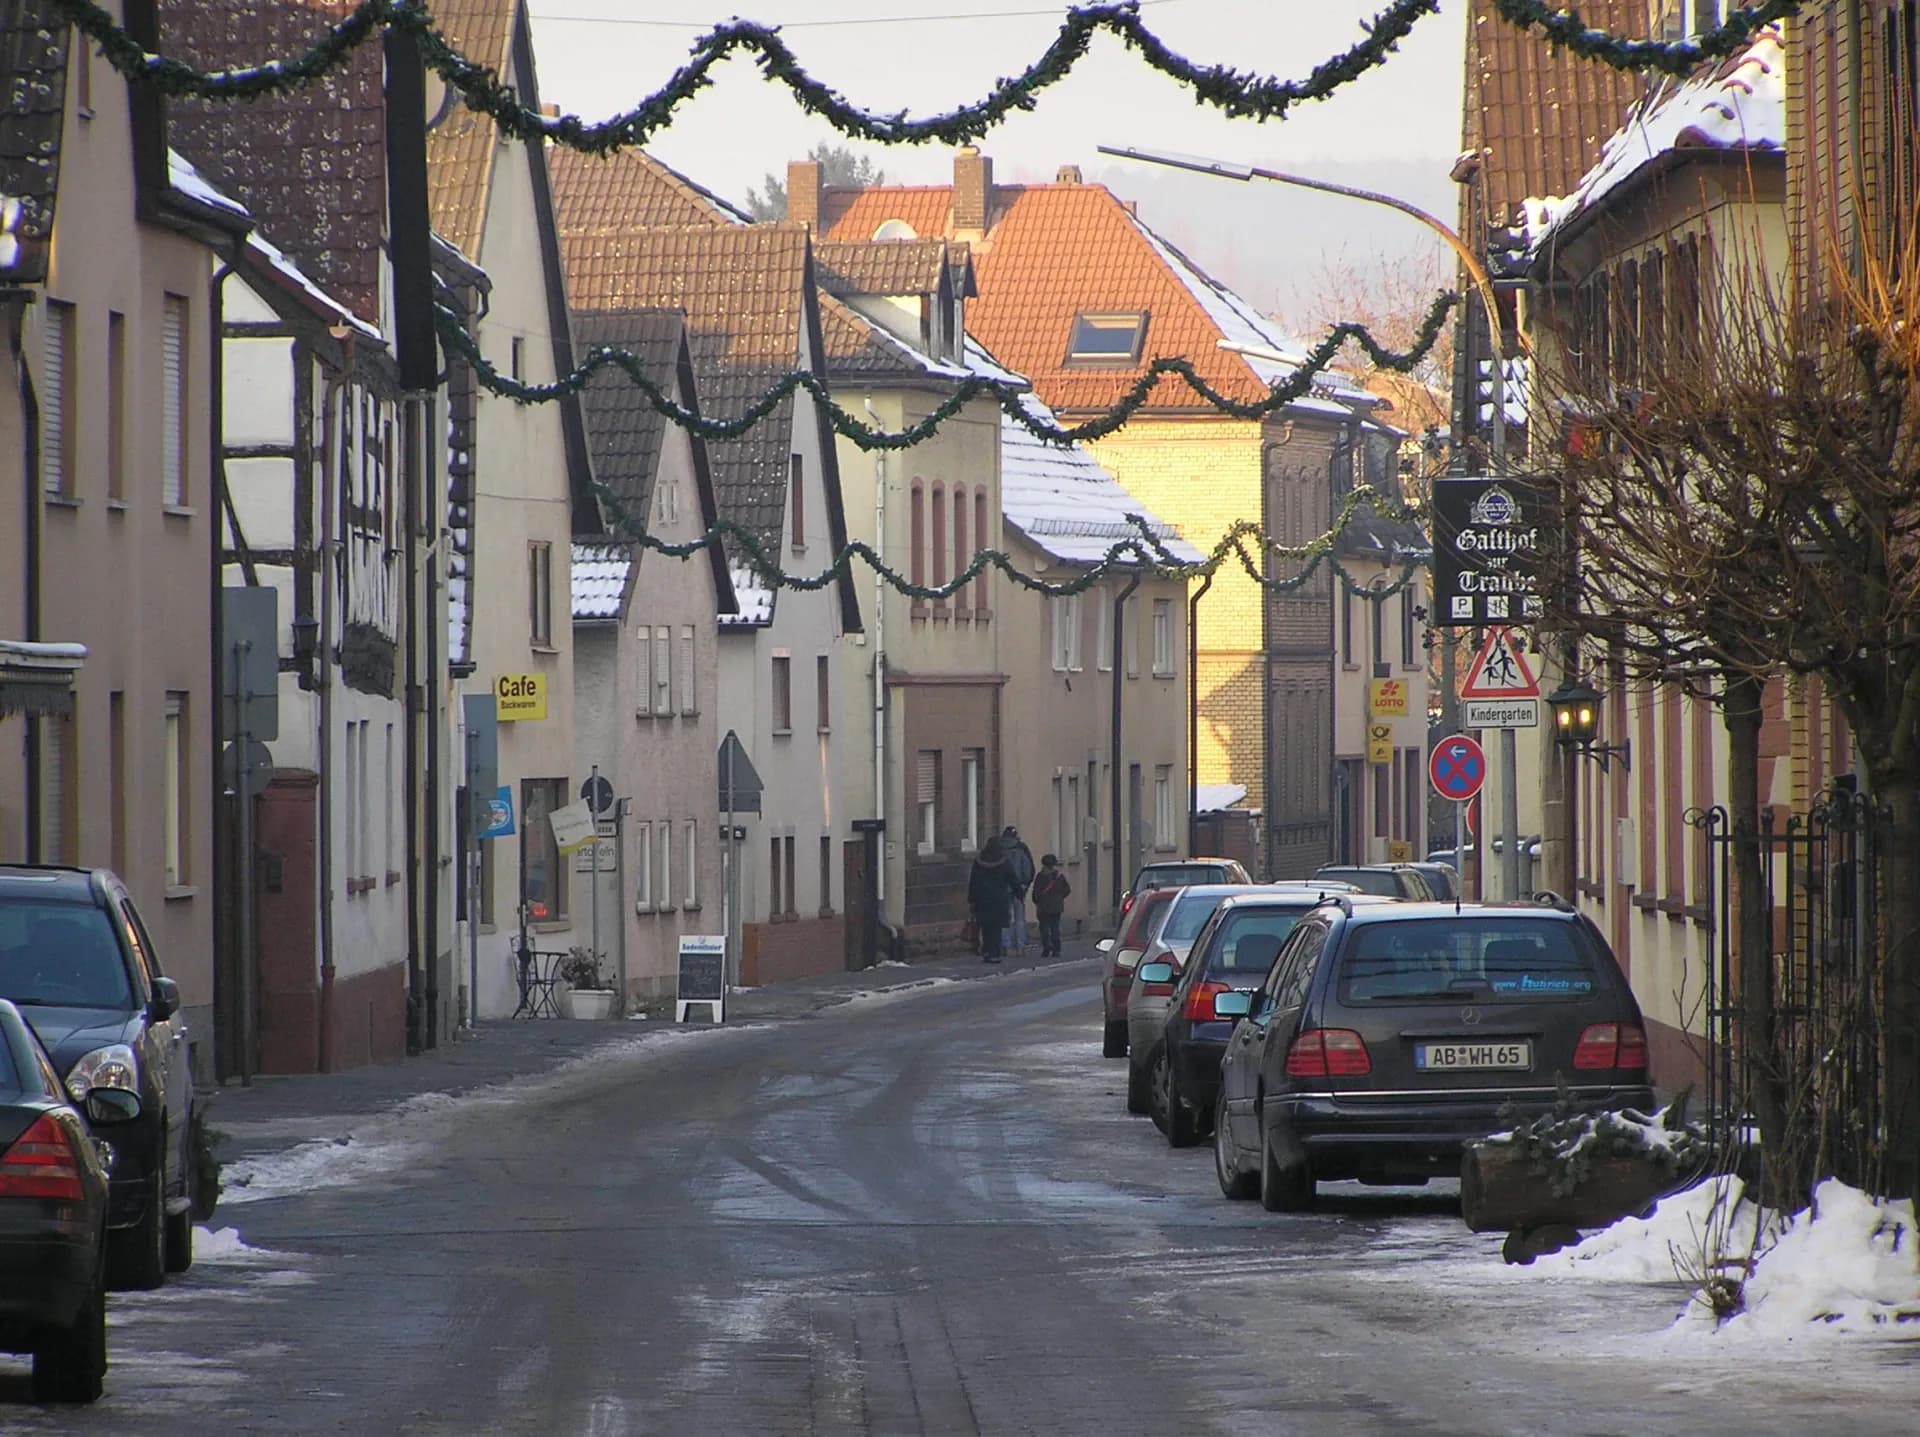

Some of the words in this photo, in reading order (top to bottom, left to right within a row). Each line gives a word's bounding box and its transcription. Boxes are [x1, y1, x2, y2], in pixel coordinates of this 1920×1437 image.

[1458, 570, 1537, 592] Traube
[1458, 598, 1468, 610] P
[499, 675, 537, 697] Cafe
[1375, 699, 1404, 707] LOTTO
[1470, 706, 1533, 724] Kindergarten
[1433, 1047, 1457, 1065] AB
[1469, 1047, 1493, 1064] WH
[1497, 1046, 1520, 1064] 65
